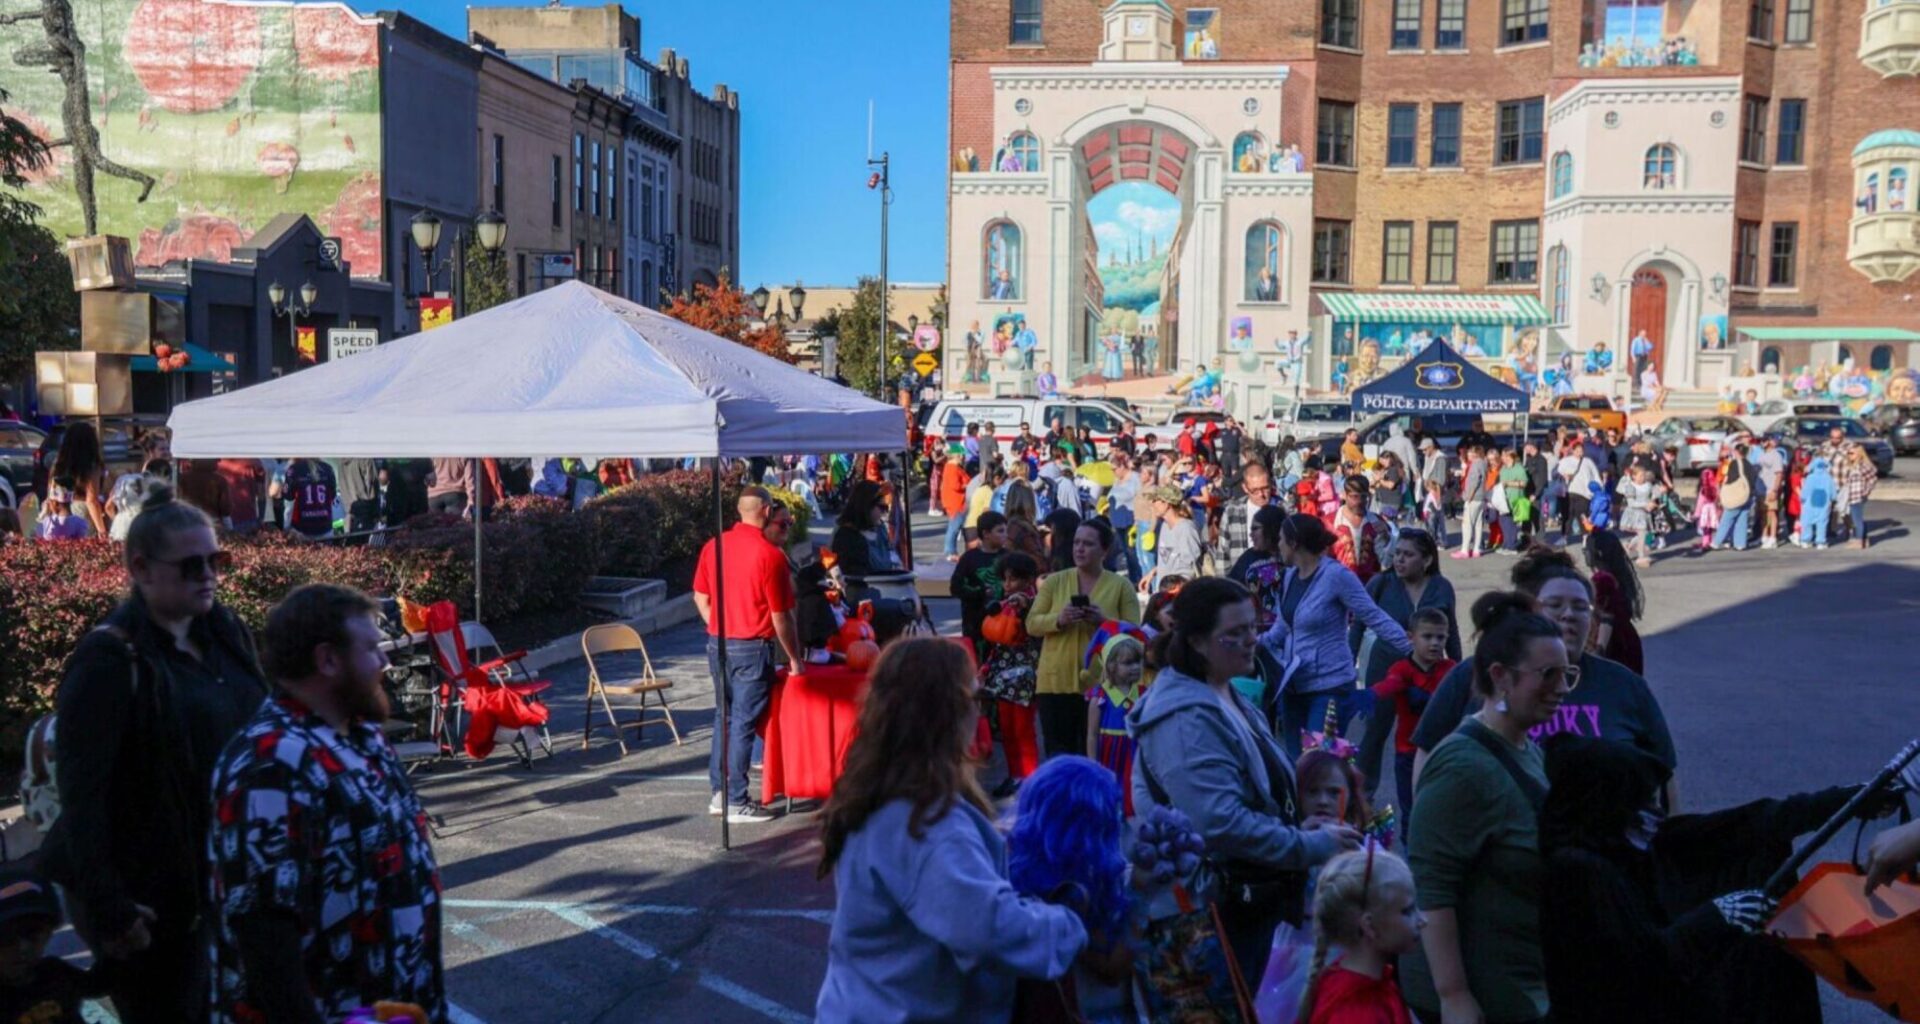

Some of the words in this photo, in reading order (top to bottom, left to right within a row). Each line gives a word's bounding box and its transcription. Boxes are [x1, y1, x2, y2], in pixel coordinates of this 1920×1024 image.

[1368, 301, 1502, 309] INSPIRATION
[333, 336, 374, 347] SPEED
[1363, 398, 1415, 410] POLICE
[1418, 399, 1520, 411] DEPARTMENT
[305, 484, 327, 504] 16
